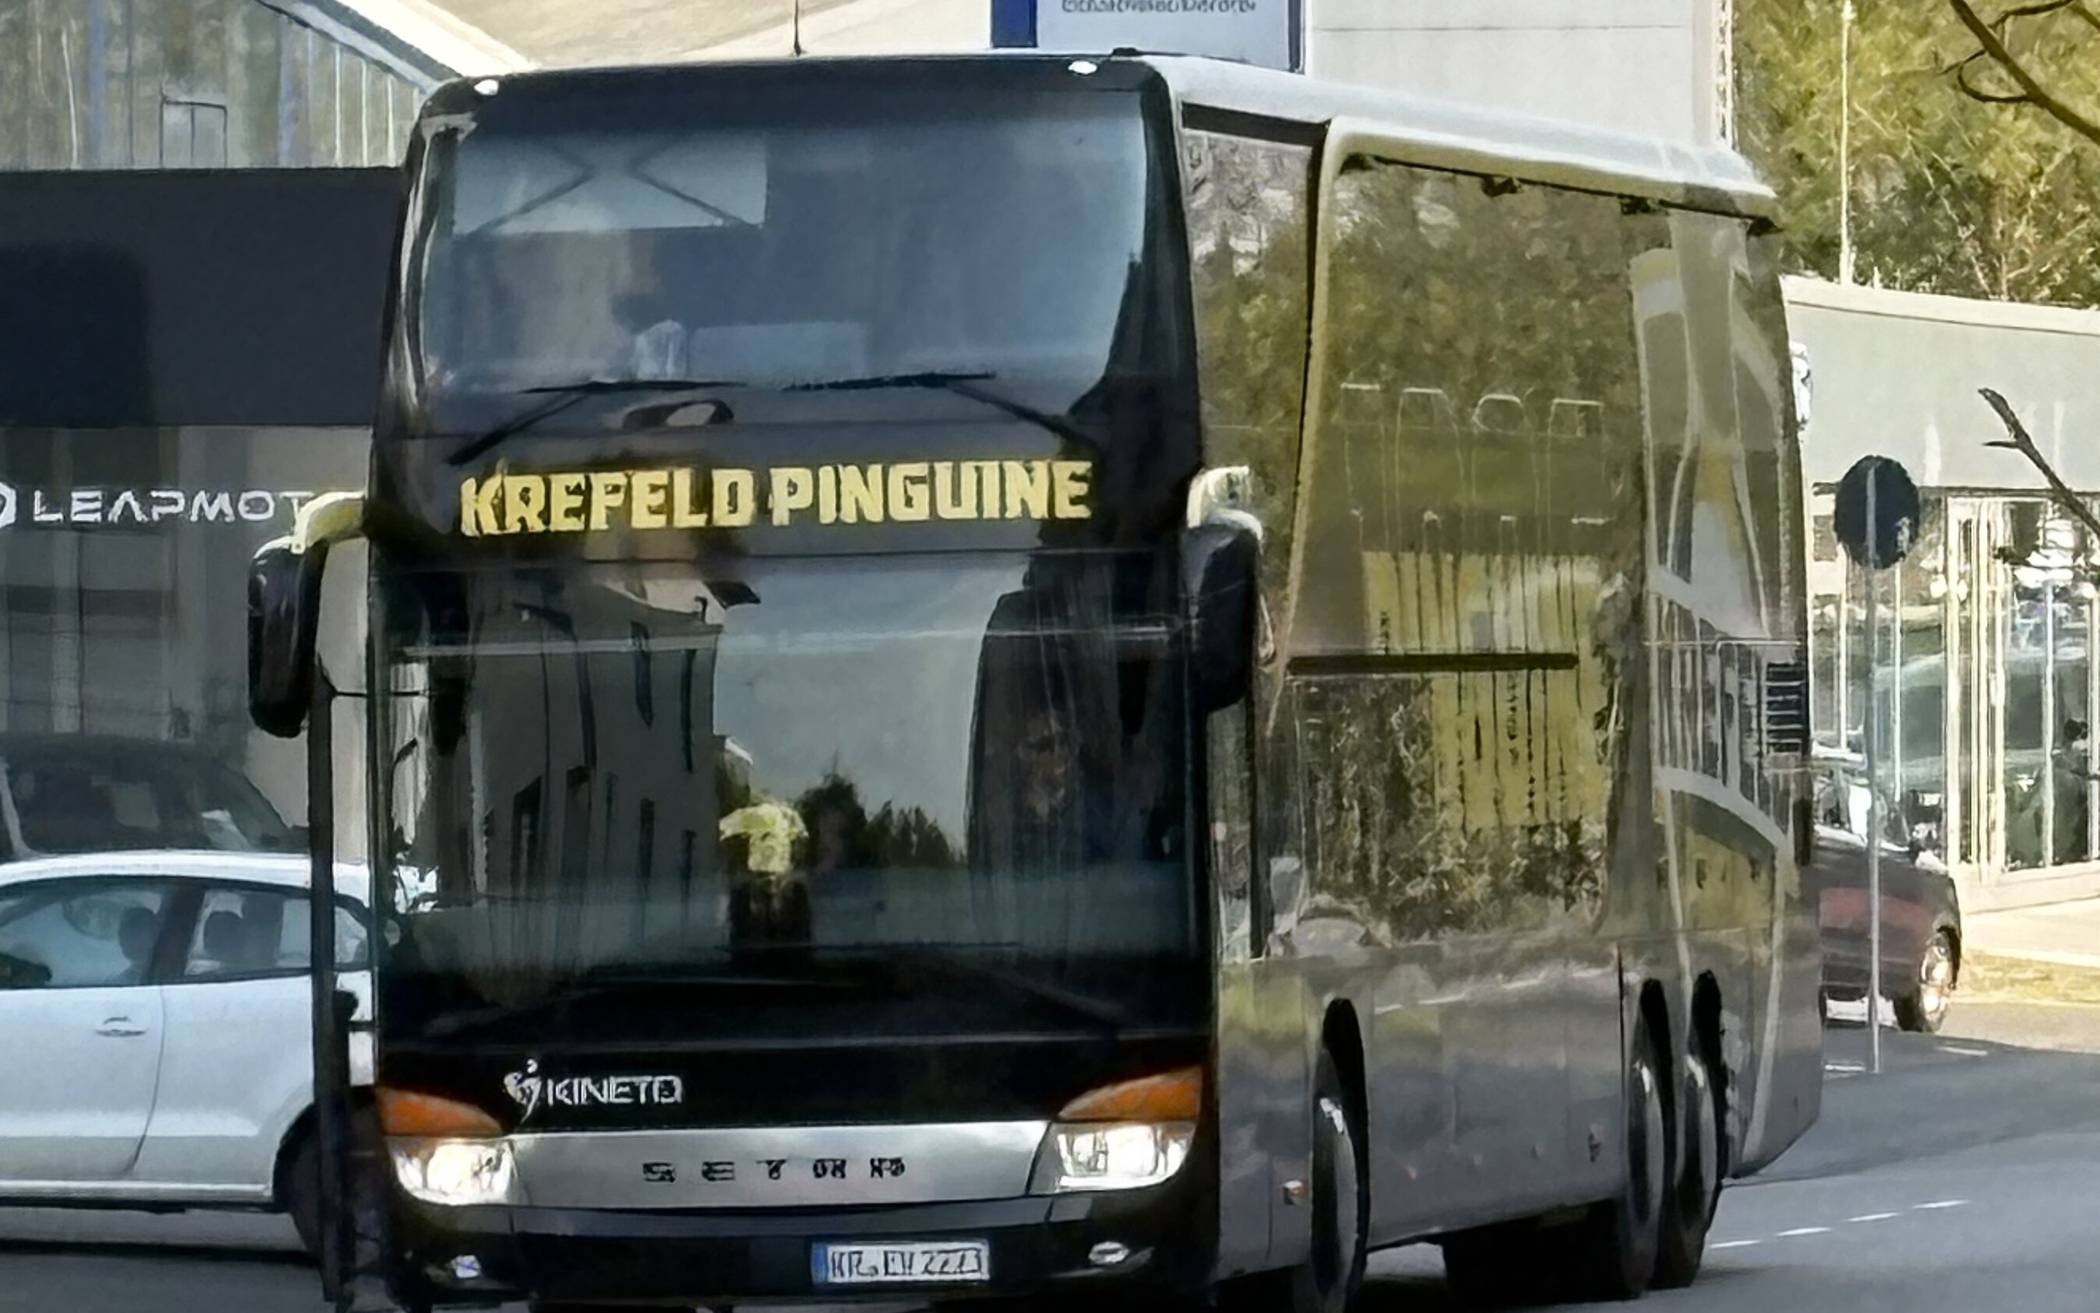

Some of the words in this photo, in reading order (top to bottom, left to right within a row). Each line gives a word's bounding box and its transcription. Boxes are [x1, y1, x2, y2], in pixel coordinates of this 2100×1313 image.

[32, 489, 314, 525] LEAPMOT
[460, 464, 756, 537] KREFELD
[769, 460, 1092, 525] PINGUINE
